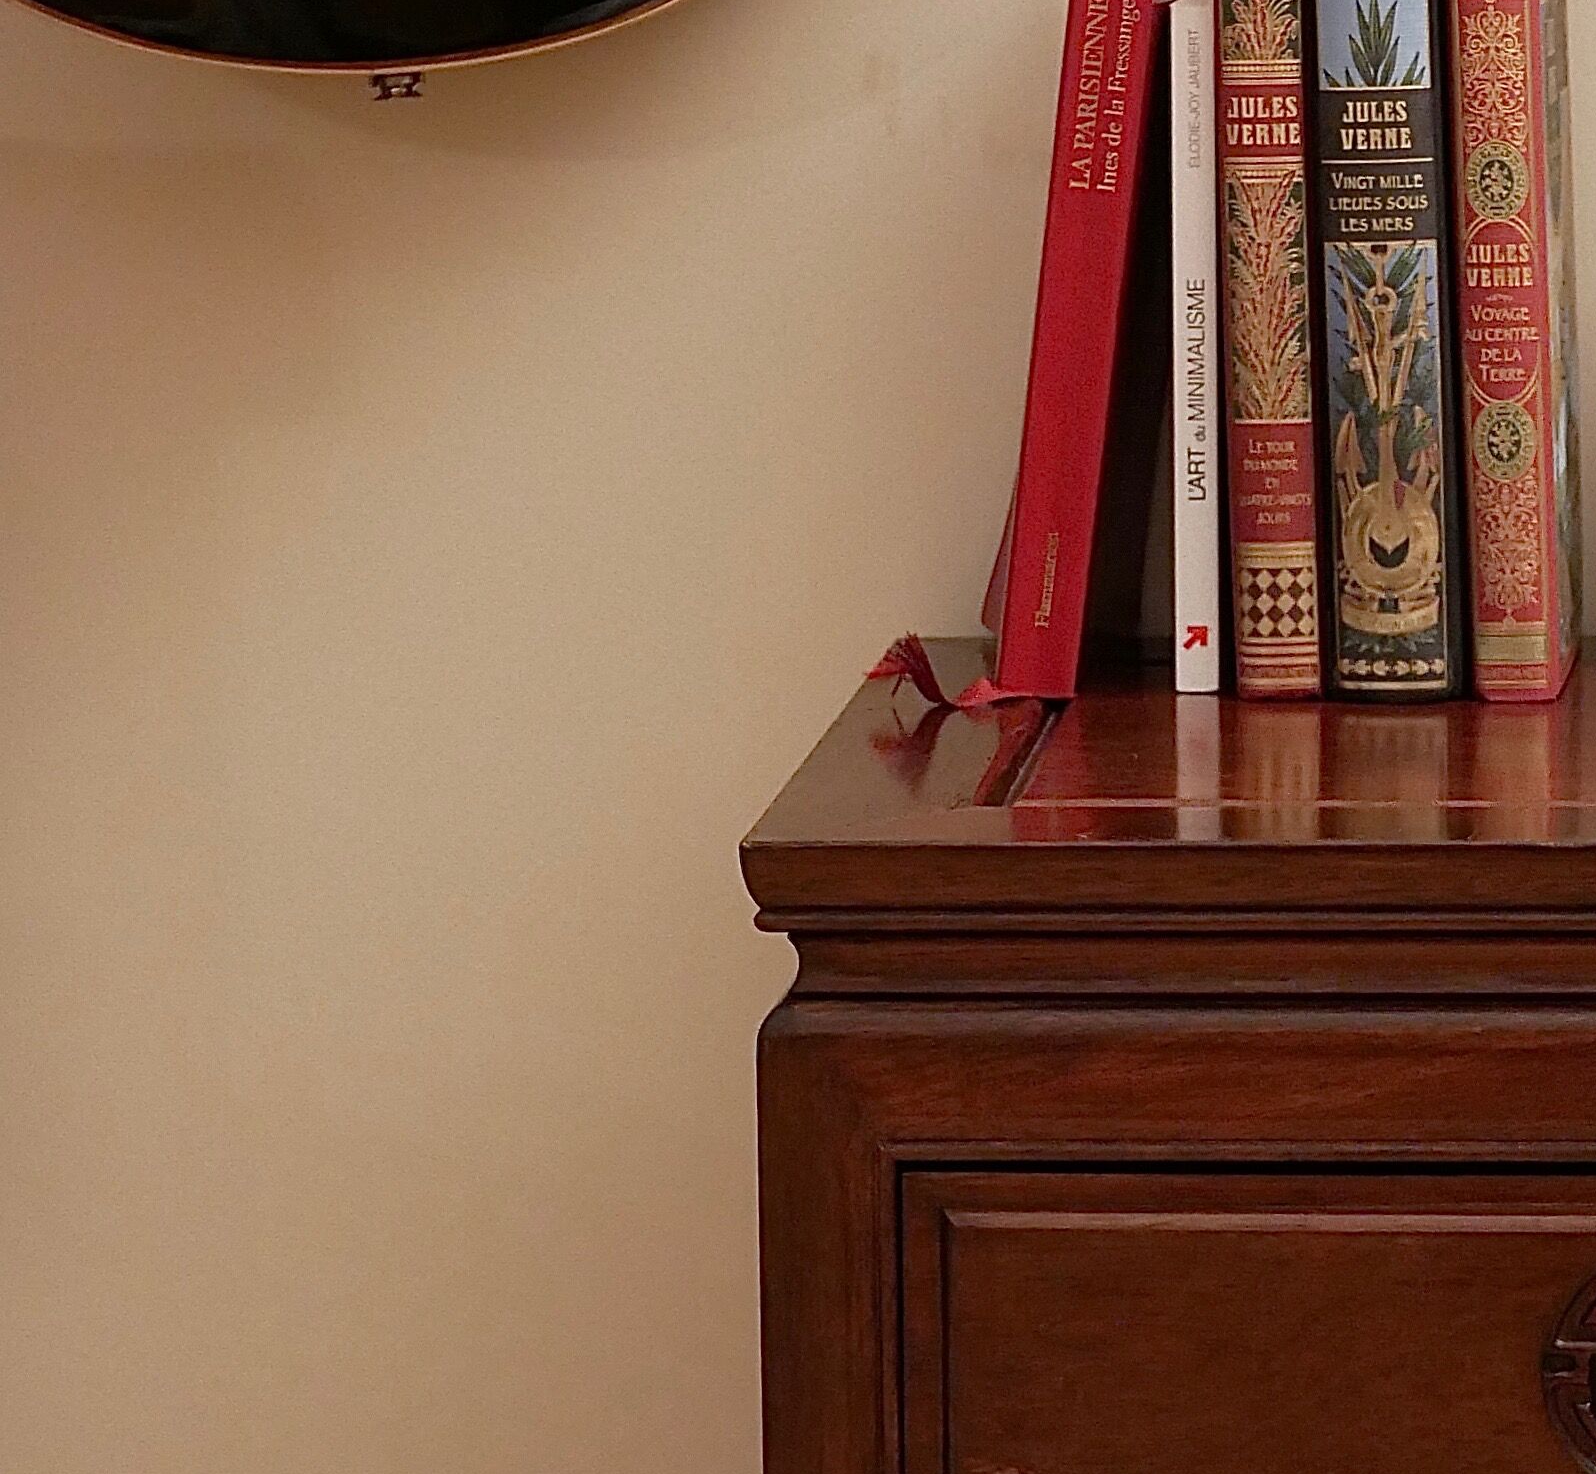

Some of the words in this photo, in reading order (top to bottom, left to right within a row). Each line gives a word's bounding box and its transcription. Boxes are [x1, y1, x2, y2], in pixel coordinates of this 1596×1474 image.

[1104, 99, 1125, 115] la
[1227, 96, 1299, 119] JULES
[1342, 100, 1409, 123] JULES
[1101, 123, 1122, 146] de
[1225, 123, 1301, 146] VERNE
[1339, 127, 1413, 150] VERNE
[1069, 156, 1092, 190] LA
[1096, 152, 1119, 193] Ines
[1386, 194, 1430, 210] SOUS
[1340, 218, 1369, 233] LES
[1371, 217, 1415, 232] MERS
[1467, 243, 1531, 264] JULES
[1465, 266, 1534, 287] VERNE
[1186, 278, 1206, 422] MINIMALISME
[1504, 348, 1523, 362] LA
[1187, 447, 1207, 502] L'ART
